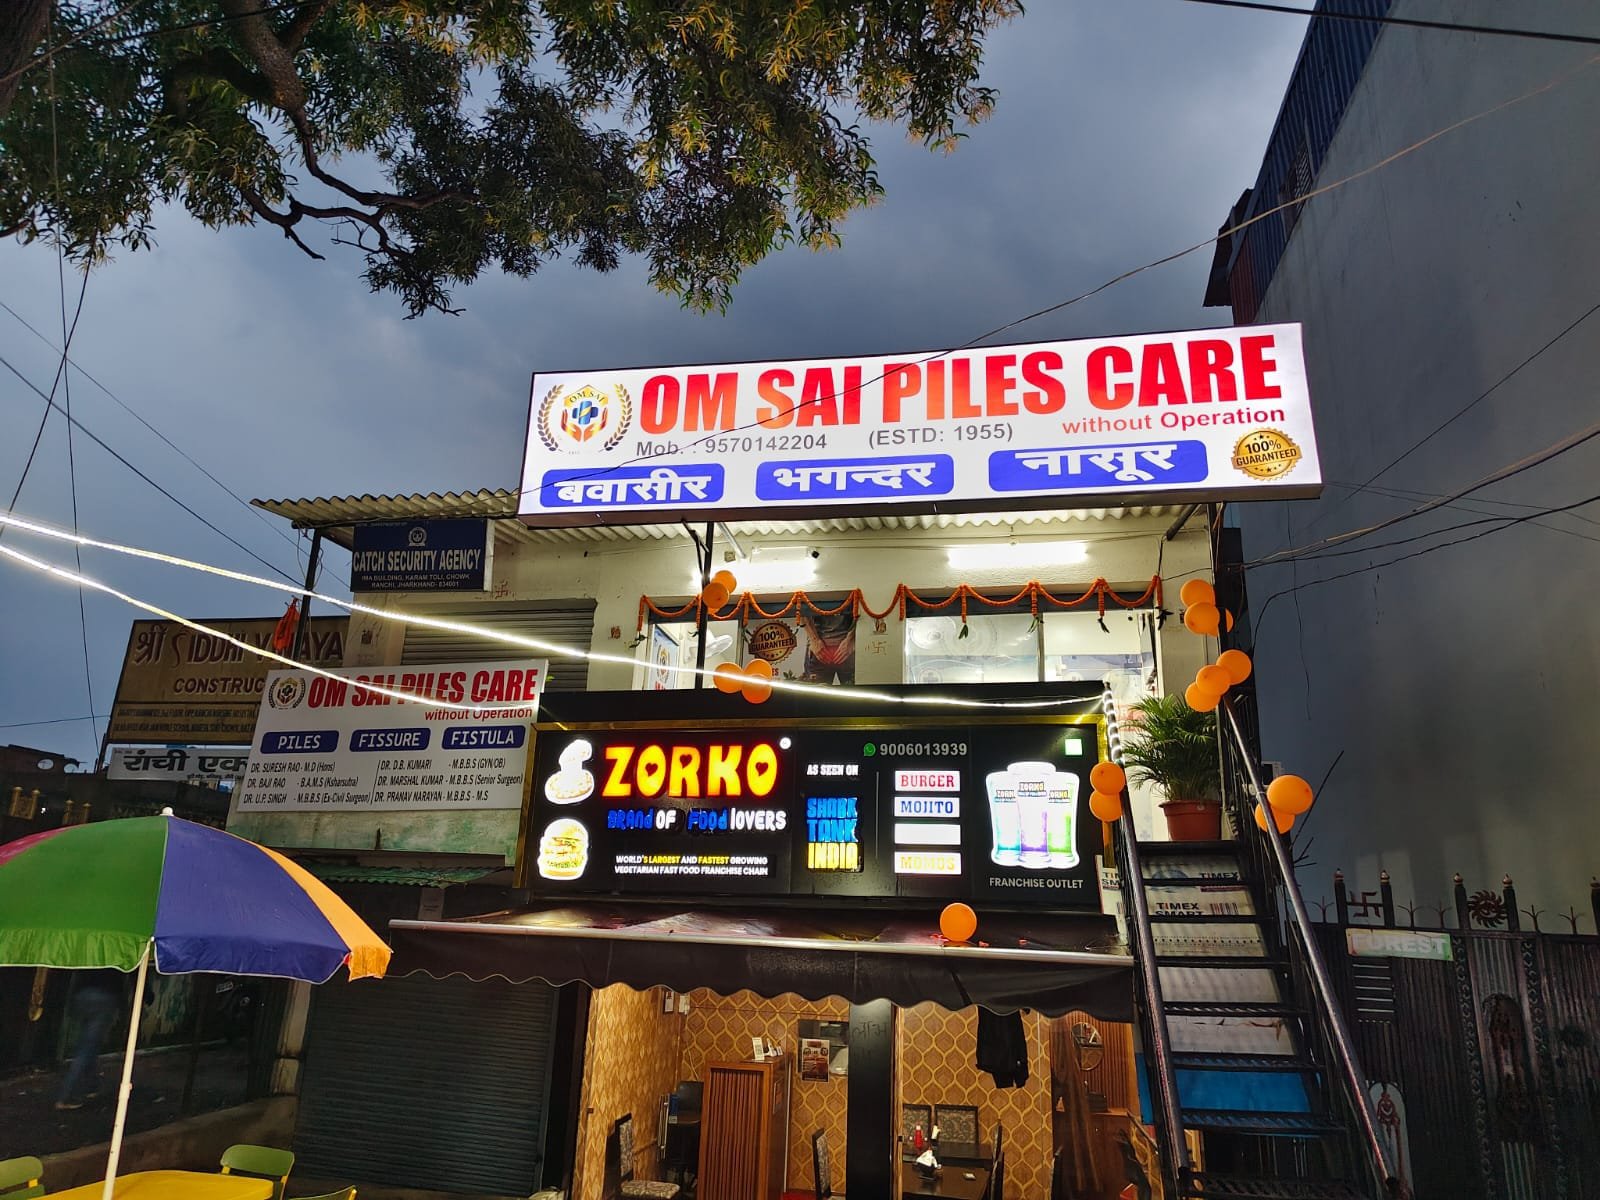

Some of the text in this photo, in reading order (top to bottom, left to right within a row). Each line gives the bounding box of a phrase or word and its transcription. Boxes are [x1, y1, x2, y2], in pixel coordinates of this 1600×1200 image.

[638, 334, 1282, 435] OM SAI PILES CARE
[569, 390, 605, 403] OM SAI
[1062, 408, 1285, 435] without Operation
[868, 422, 1014, 450] (ESTD: 1955)
[705, 434, 827, 454] 9570142204
[1244, 439, 1282, 454] 100%
[1014, 443, 1177, 482] नासूर
[1235, 446, 1298, 467] GUARANTEED
[772, 460, 937, 493] भगन्दर
[554, 466, 711, 504] बवासीर
[353, 548, 481, 572] CATCH SECURITY AGENCY
[758, 631, 784, 642] 100%
[308, 669, 538, 708] OM SAI PILES CARE
[425, 708, 532, 722] without Operation
[277, 733, 321, 750] PILES
[358, 731, 422, 748] FISSURE
[450, 729, 515, 746] FISTULA
[880, 743, 968, 756] 9006013939
[123, 749, 190, 772] रांची
[250, 764, 260, 773] DR.
[262, 763, 286, 772] SURESH
[380, 760, 391, 770] DR.
[406, 759, 432, 770] KUMARI
[452, 758, 477, 769] M.B.B.S
[601, 743, 778, 798] ZORKO
[806, 764, 859, 776] AS SEEN ON
[247, 778, 257, 788] DR.
[272, 778, 286, 788] RAO
[377, 776, 388, 786] DR.
[390, 775, 419, 786] MARSHAL
[420, 775, 444, 786] KUMAR
[449, 774, 474, 786] M.B.B.S
[900, 774, 955, 788] BURGER
[244, 794, 254, 804] DR.
[268, 794, 288, 804] SINGH
[297, 793, 320, 803] M.B.B.S
[374, 792, 385, 802] DR.
[386, 791, 413, 802] PRANAV
[446, 790, 472, 802] M.B.B.S
[476, 790, 490, 801] M.S
[807, 797, 858, 818] SHARK
[900, 801, 954, 814] MOJITO
[656, 809, 677, 830] OF
[806, 818, 859, 842] TANK
[616, 855, 768, 865] WORLD'S LARGEST AND FASTEST GROWING
[808, 842, 858, 869] INDIA
[900, 855, 956, 870] MOMOS
[614, 865, 659, 874] VEGETARIAN
[660, 866, 678, 875] FAST
[679, 866, 700, 875] FOOD
[701, 866, 742, 876] FRANCHISE
[1200, 872, 1239, 881] TIMEX
[989, 877, 1084, 889] FRANCHISE OUTLET
[1156, 902, 1200, 910] TIMEX
